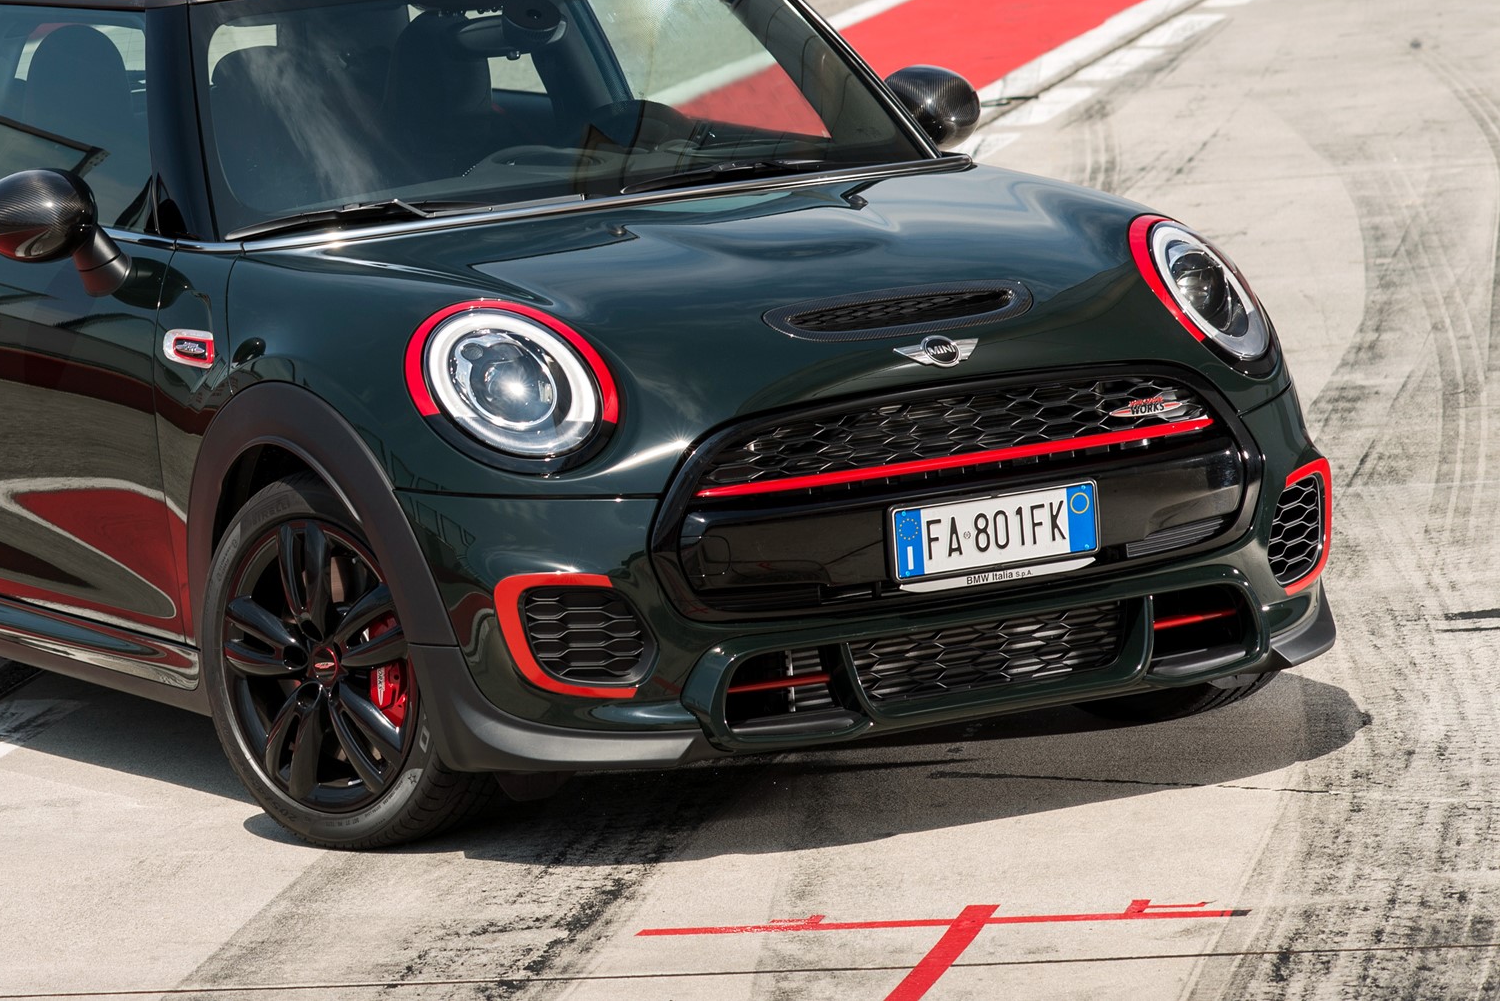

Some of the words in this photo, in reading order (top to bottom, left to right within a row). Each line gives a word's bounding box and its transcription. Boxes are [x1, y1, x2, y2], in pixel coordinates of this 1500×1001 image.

[927, 344, 956, 355] MINI
[1130, 403, 1164, 415] WORKS
[907, 546, 914, 570] I
[966, 573, 990, 585] BMW
[992, 570, 1014, 581] Italia
